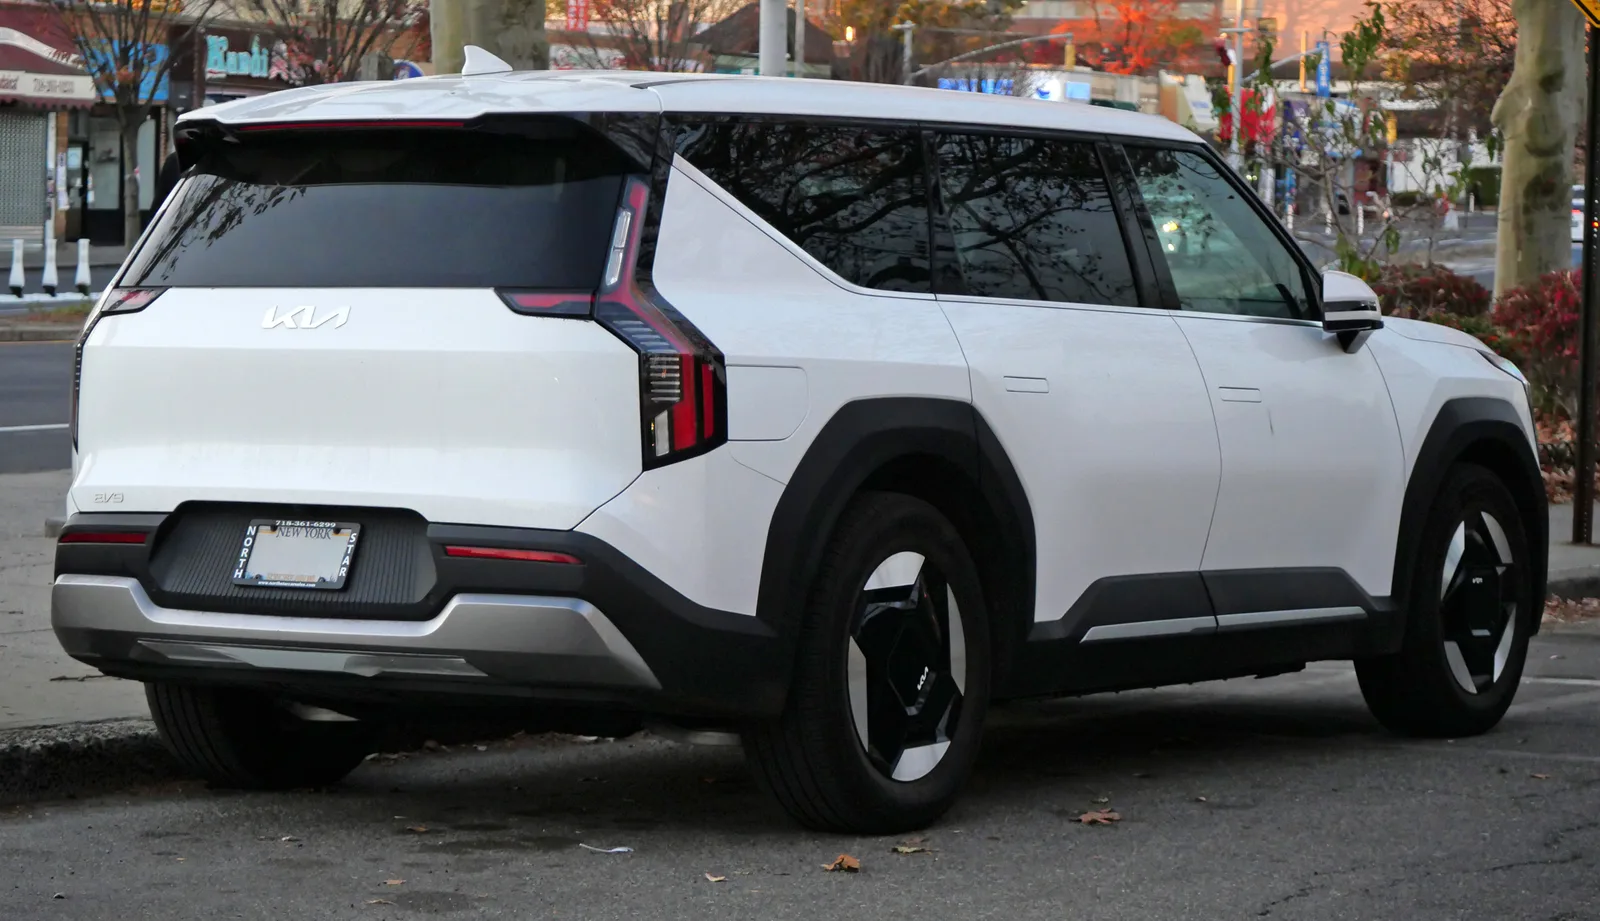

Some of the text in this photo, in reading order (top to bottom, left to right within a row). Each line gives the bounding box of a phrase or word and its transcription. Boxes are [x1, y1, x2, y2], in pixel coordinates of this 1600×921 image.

[275, 520, 336, 528] 718-361-6299
[276, 527, 331, 540] NEW YORK
[233, 525, 257, 579] NORTH
[338, 532, 357, 577] STAR
